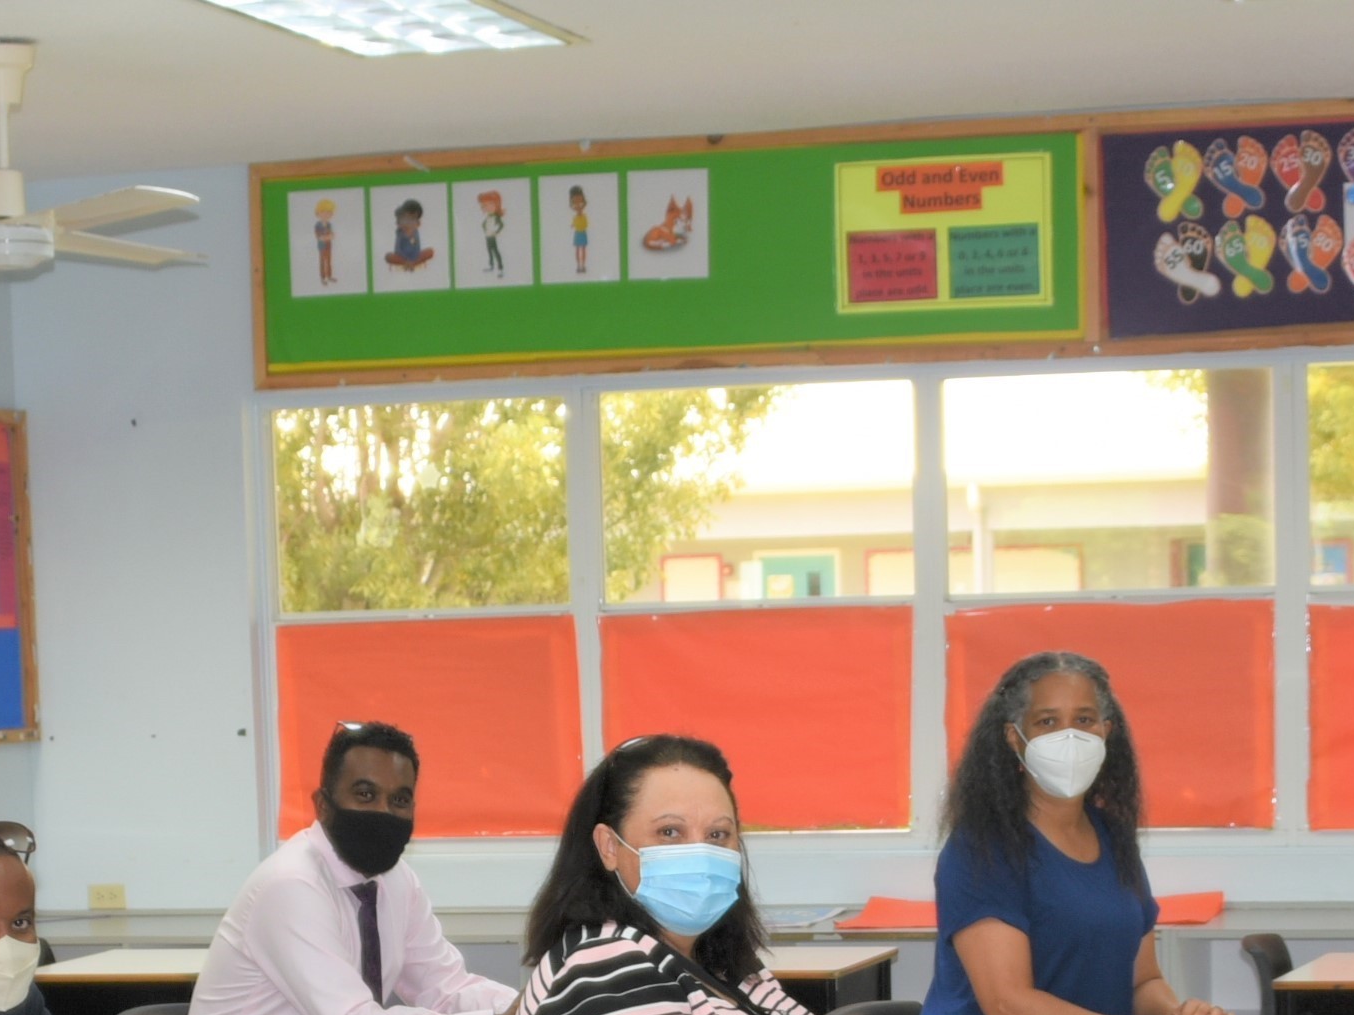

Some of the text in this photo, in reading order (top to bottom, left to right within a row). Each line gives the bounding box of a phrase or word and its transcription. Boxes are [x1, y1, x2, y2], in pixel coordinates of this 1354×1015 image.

[1239, 153, 1259, 169] 20
[1279, 155, 1298, 172] 25
[1302, 148, 1323, 166] 30
[882, 168, 999, 186] Odd and Even
[1213, 160, 1233, 180] 15
[1155, 170, 1171, 190] 5
[904, 192, 981, 208] Numbers
[1184, 240, 1203, 255] 60
[1225, 238, 1244, 257] 65
[1315, 232, 1333, 251] 80
[1164, 248, 1184, 270] 55
